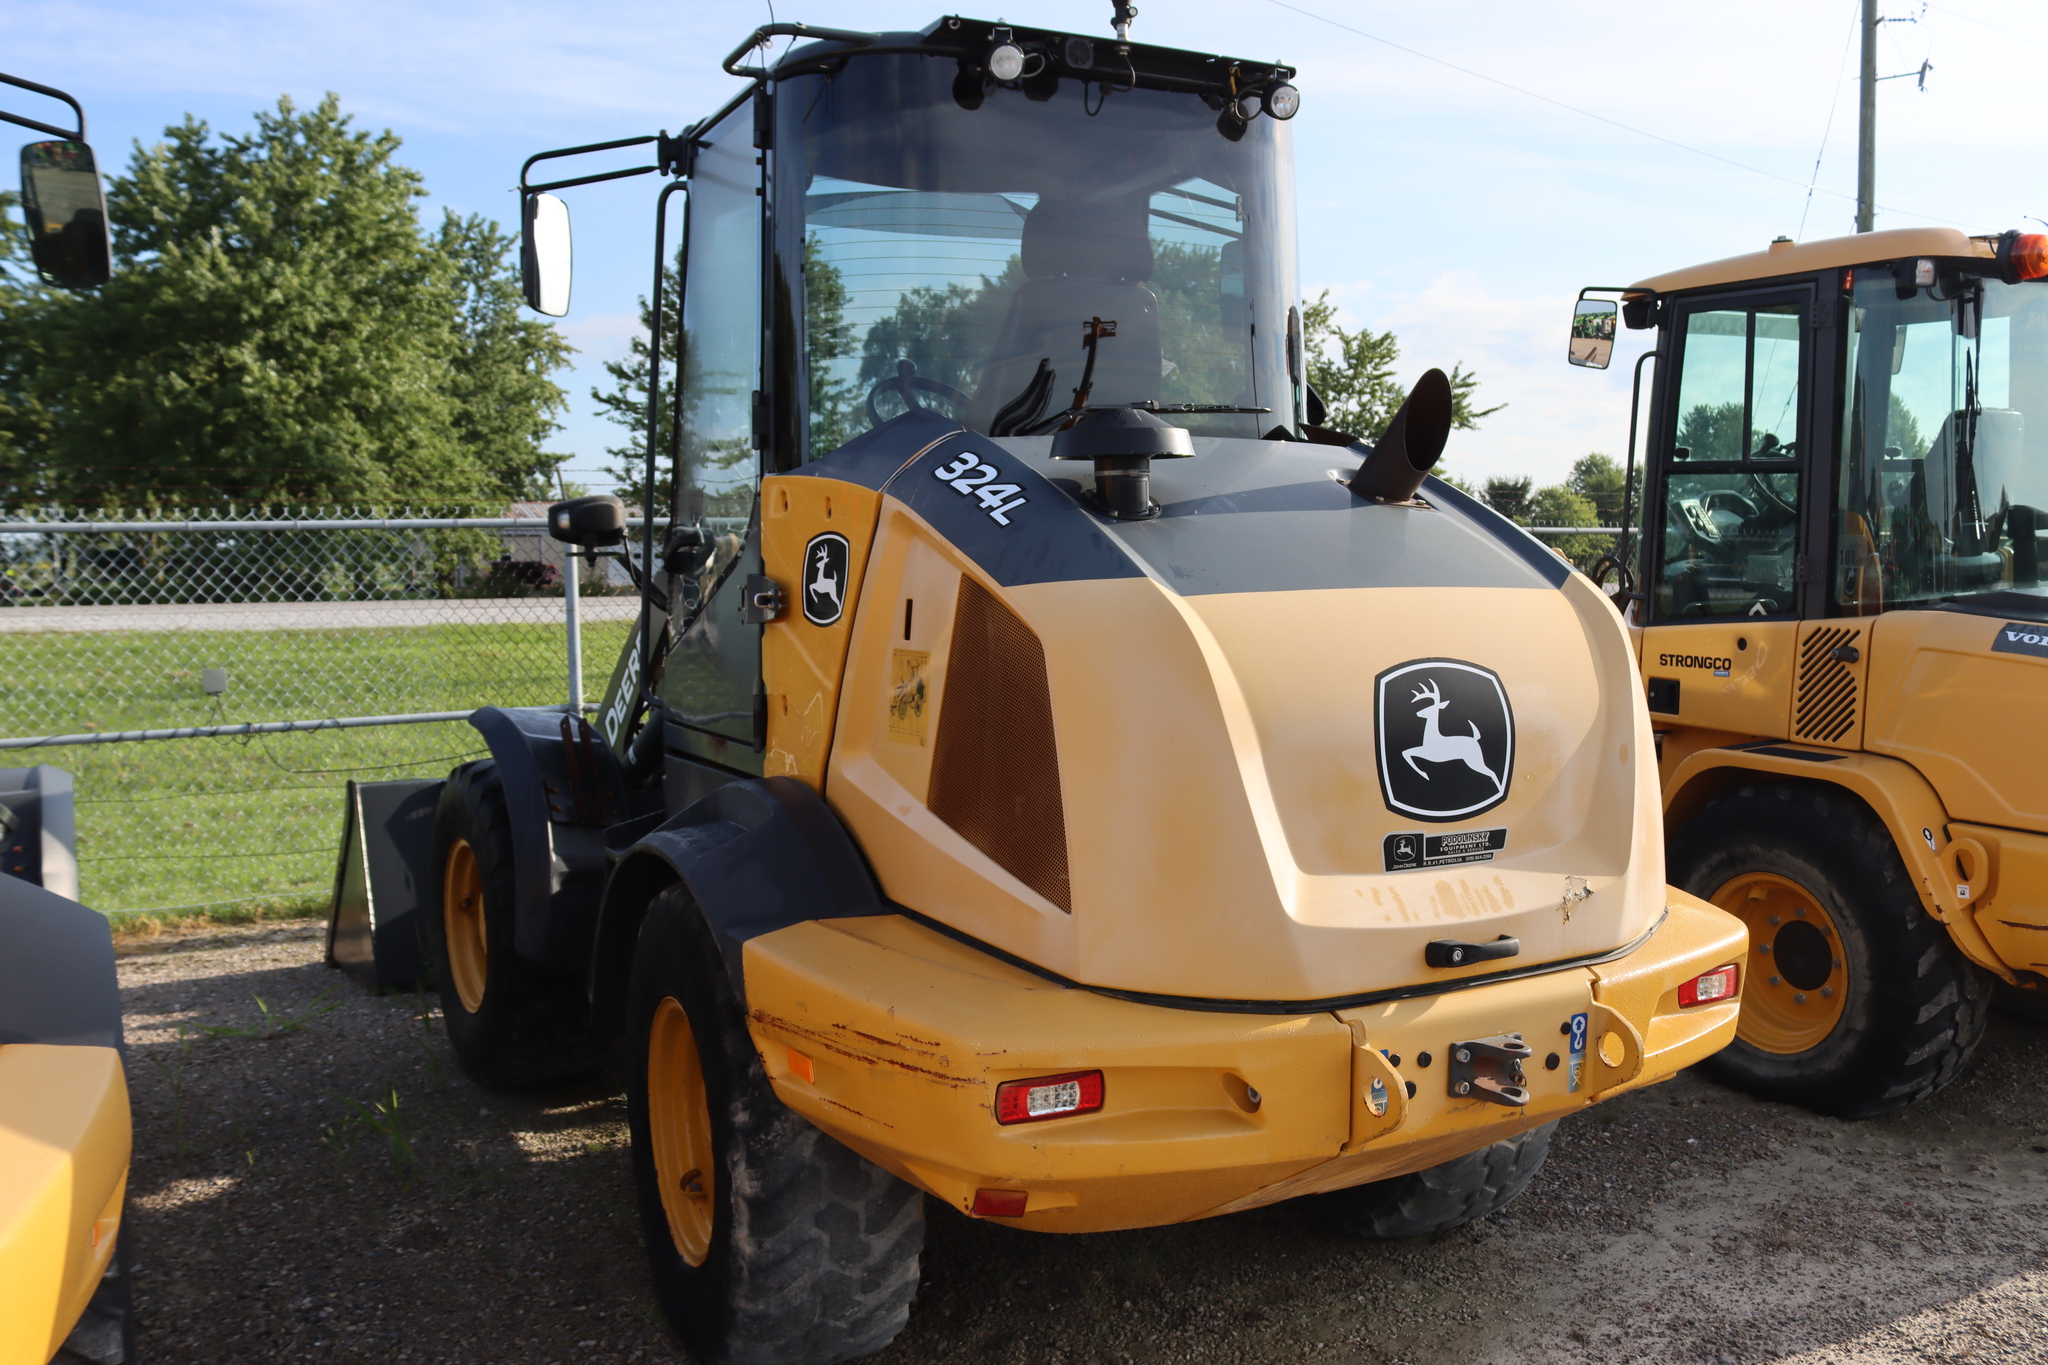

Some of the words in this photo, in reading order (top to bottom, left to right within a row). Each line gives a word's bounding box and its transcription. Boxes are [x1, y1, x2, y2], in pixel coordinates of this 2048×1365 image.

[933, 451, 1028, 527] 324L
[2005, 631, 2048, 646] VOL
[1659, 653, 1732, 671] STRONGCO
[604, 629, 641, 748] DEER
[1440, 843, 1477, 852] EQUIPMENT
[1441, 831, 1490, 847] PODOLINSKY
